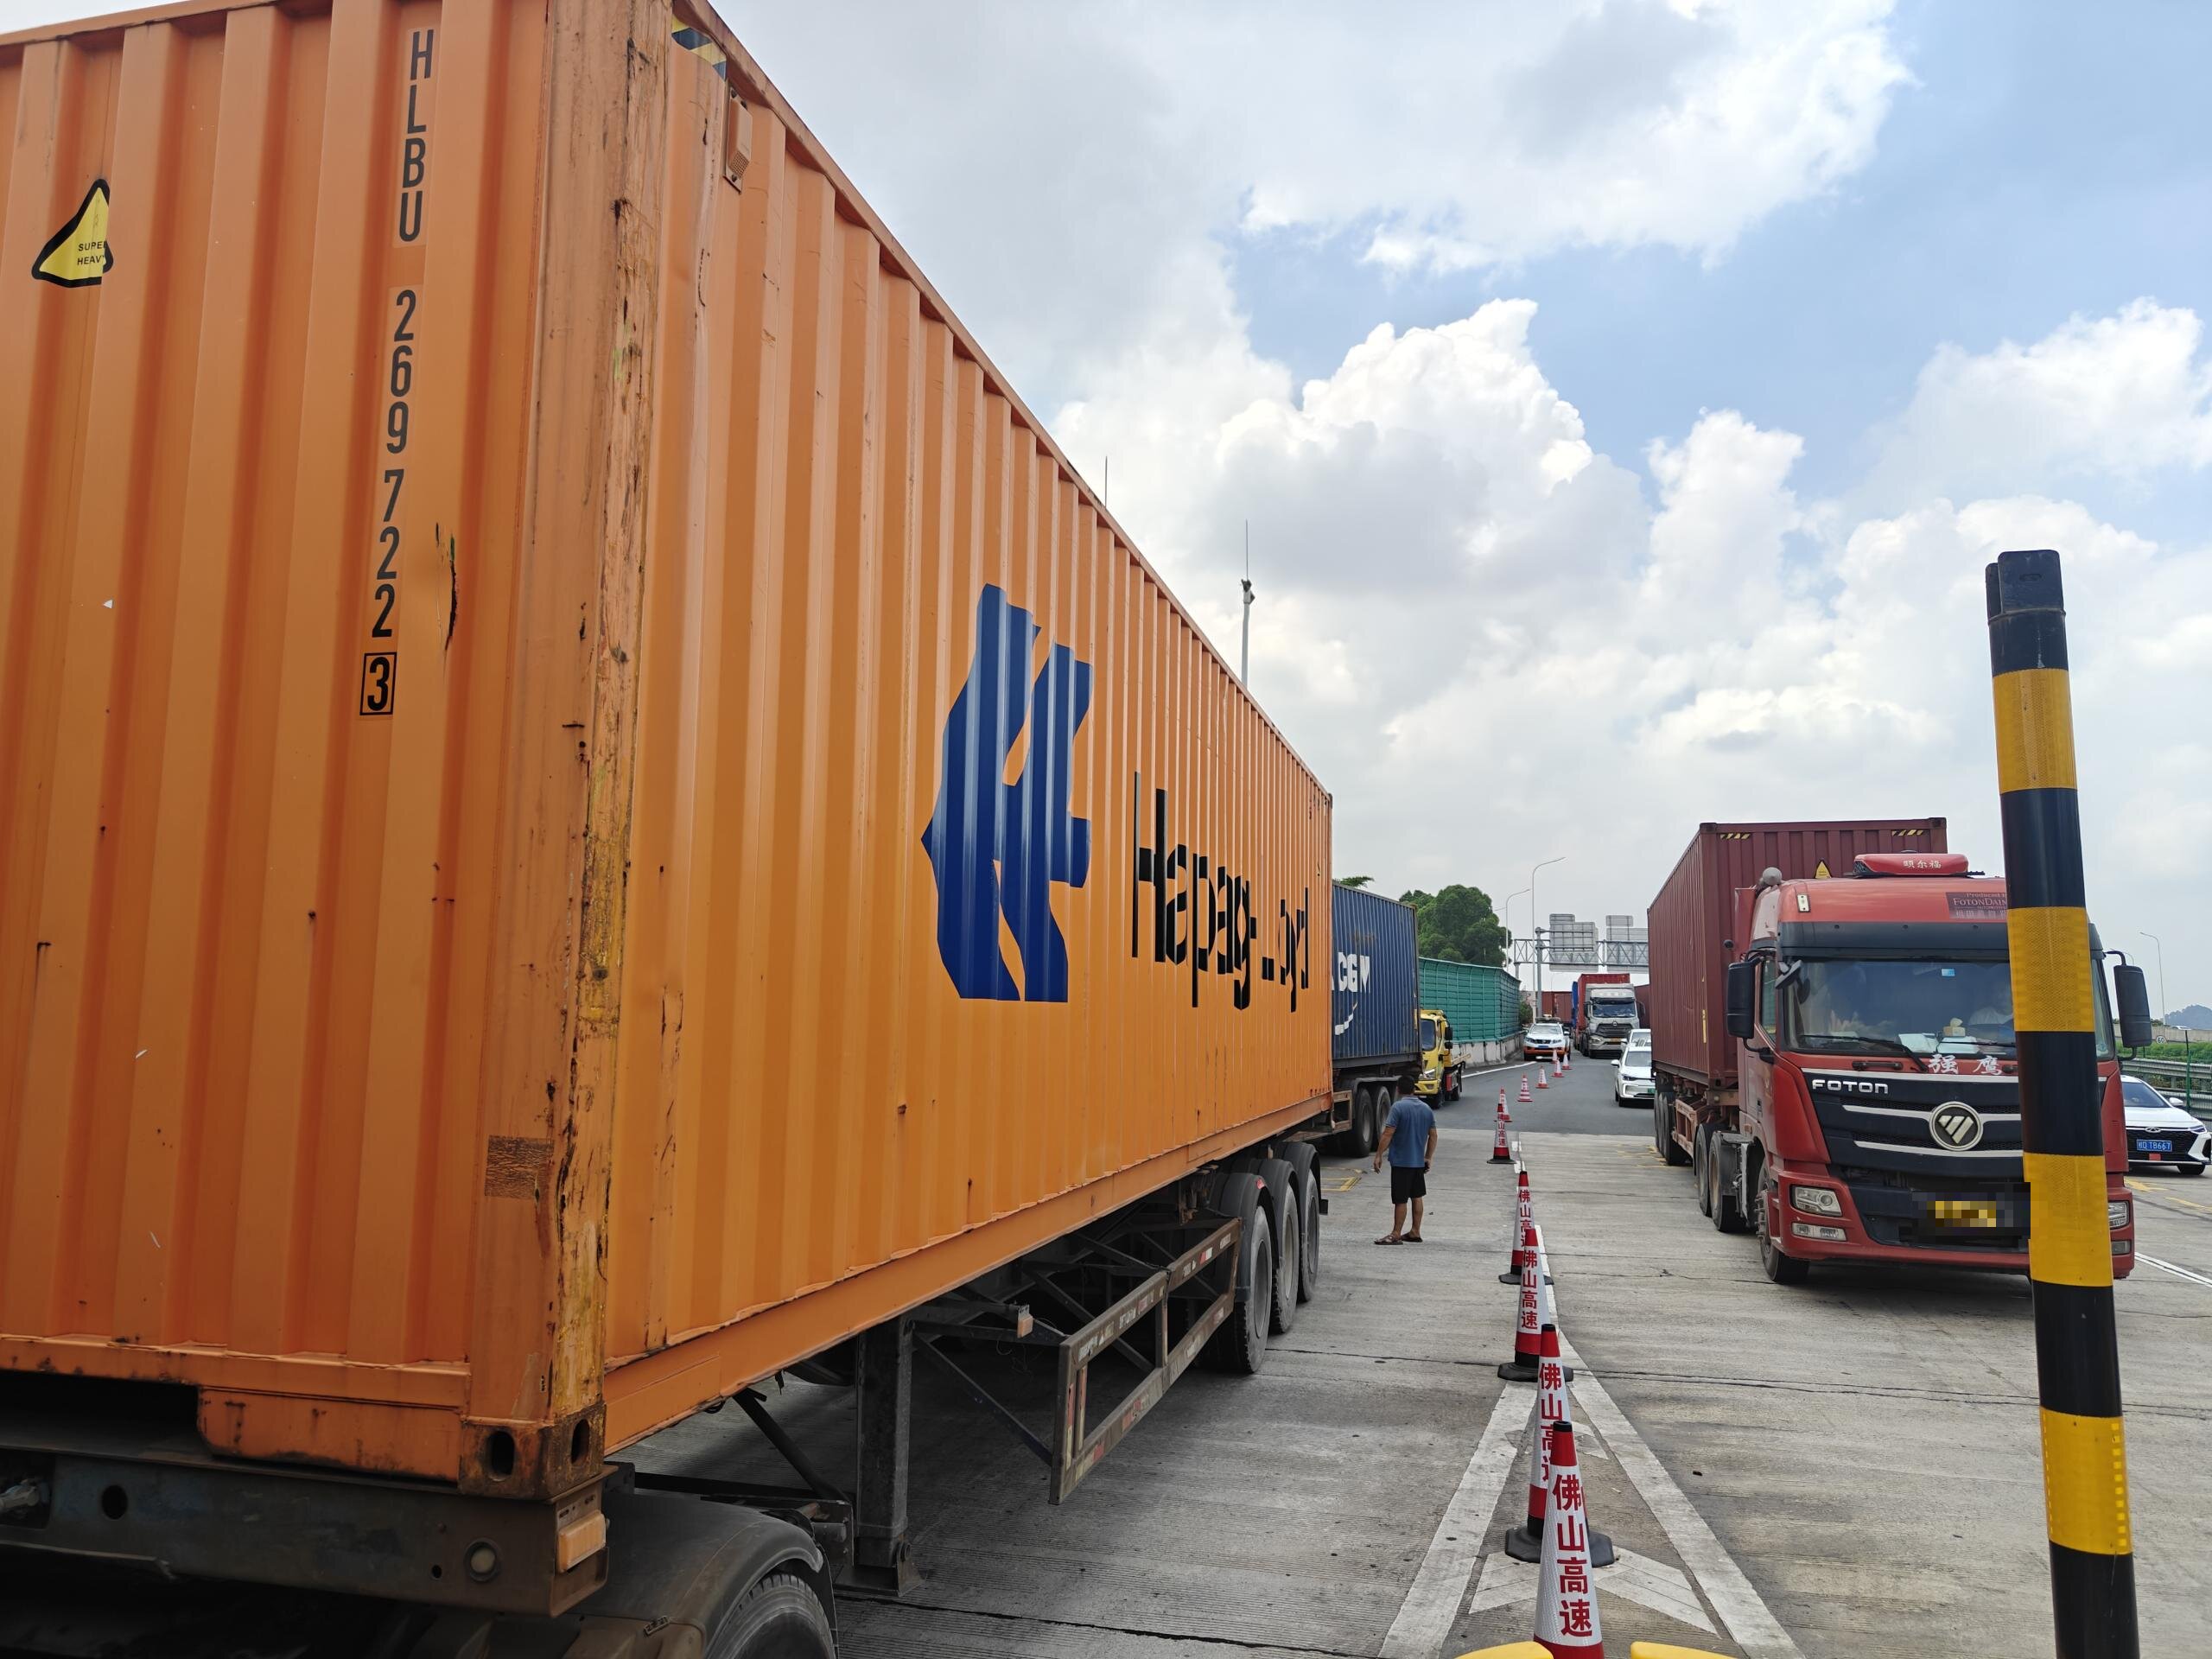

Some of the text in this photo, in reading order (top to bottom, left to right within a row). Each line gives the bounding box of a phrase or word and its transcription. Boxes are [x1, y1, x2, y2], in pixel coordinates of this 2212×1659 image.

[398, 29, 434, 243] HLBU
[77, 255, 105, 265] HEAV
[366, 655, 393, 712] 3
[1338, 951, 1370, 993] CGM
[1811, 1079, 1889, 1095] FOTON
[1521, 1249, 1539, 1330] 佛山高速
[1552, 1473, 1593, 1638] 佛山高速
